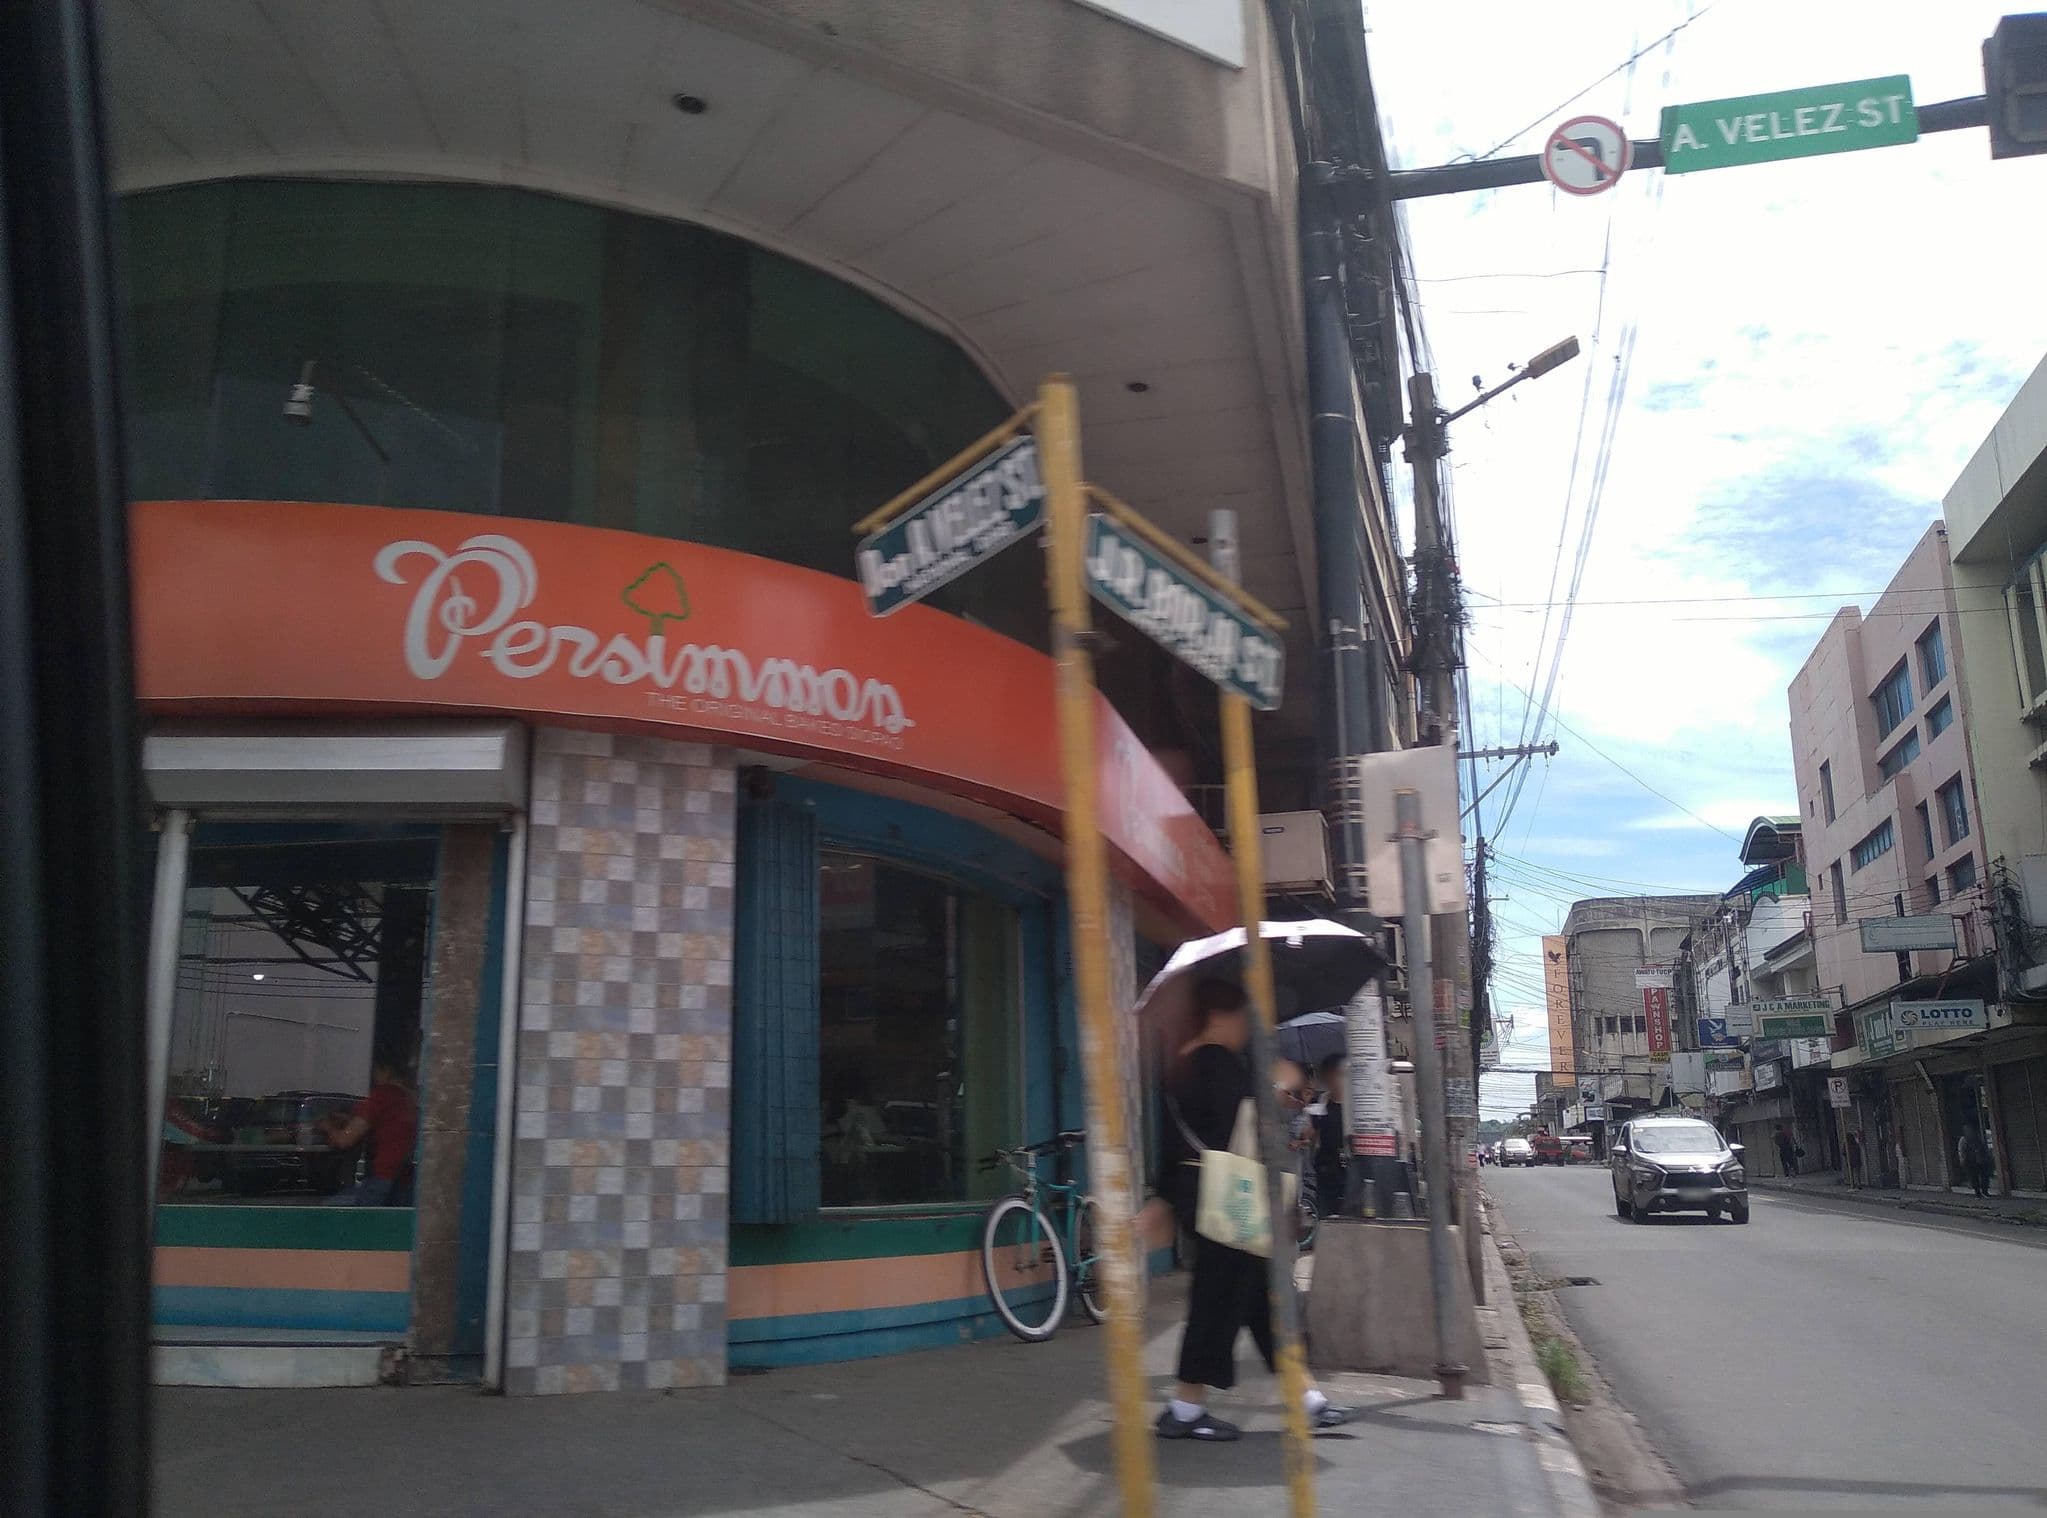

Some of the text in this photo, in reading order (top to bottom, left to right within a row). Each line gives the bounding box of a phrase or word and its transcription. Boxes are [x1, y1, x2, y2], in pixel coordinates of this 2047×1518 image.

[1671, 95, 1906, 152] A. VELEZ ST
[374, 534, 915, 734] Persimmon
[644, 691, 688, 711] THE
[694, 698, 783, 727] ORIGINAL
[1552, 971, 1570, 1073] FOREVER
[1650, 988, 1664, 1049] PAWNSHOP
[1784, 1000, 1831, 1010] MARKETING
[1920, 1008, 1973, 1019] LOTTO
